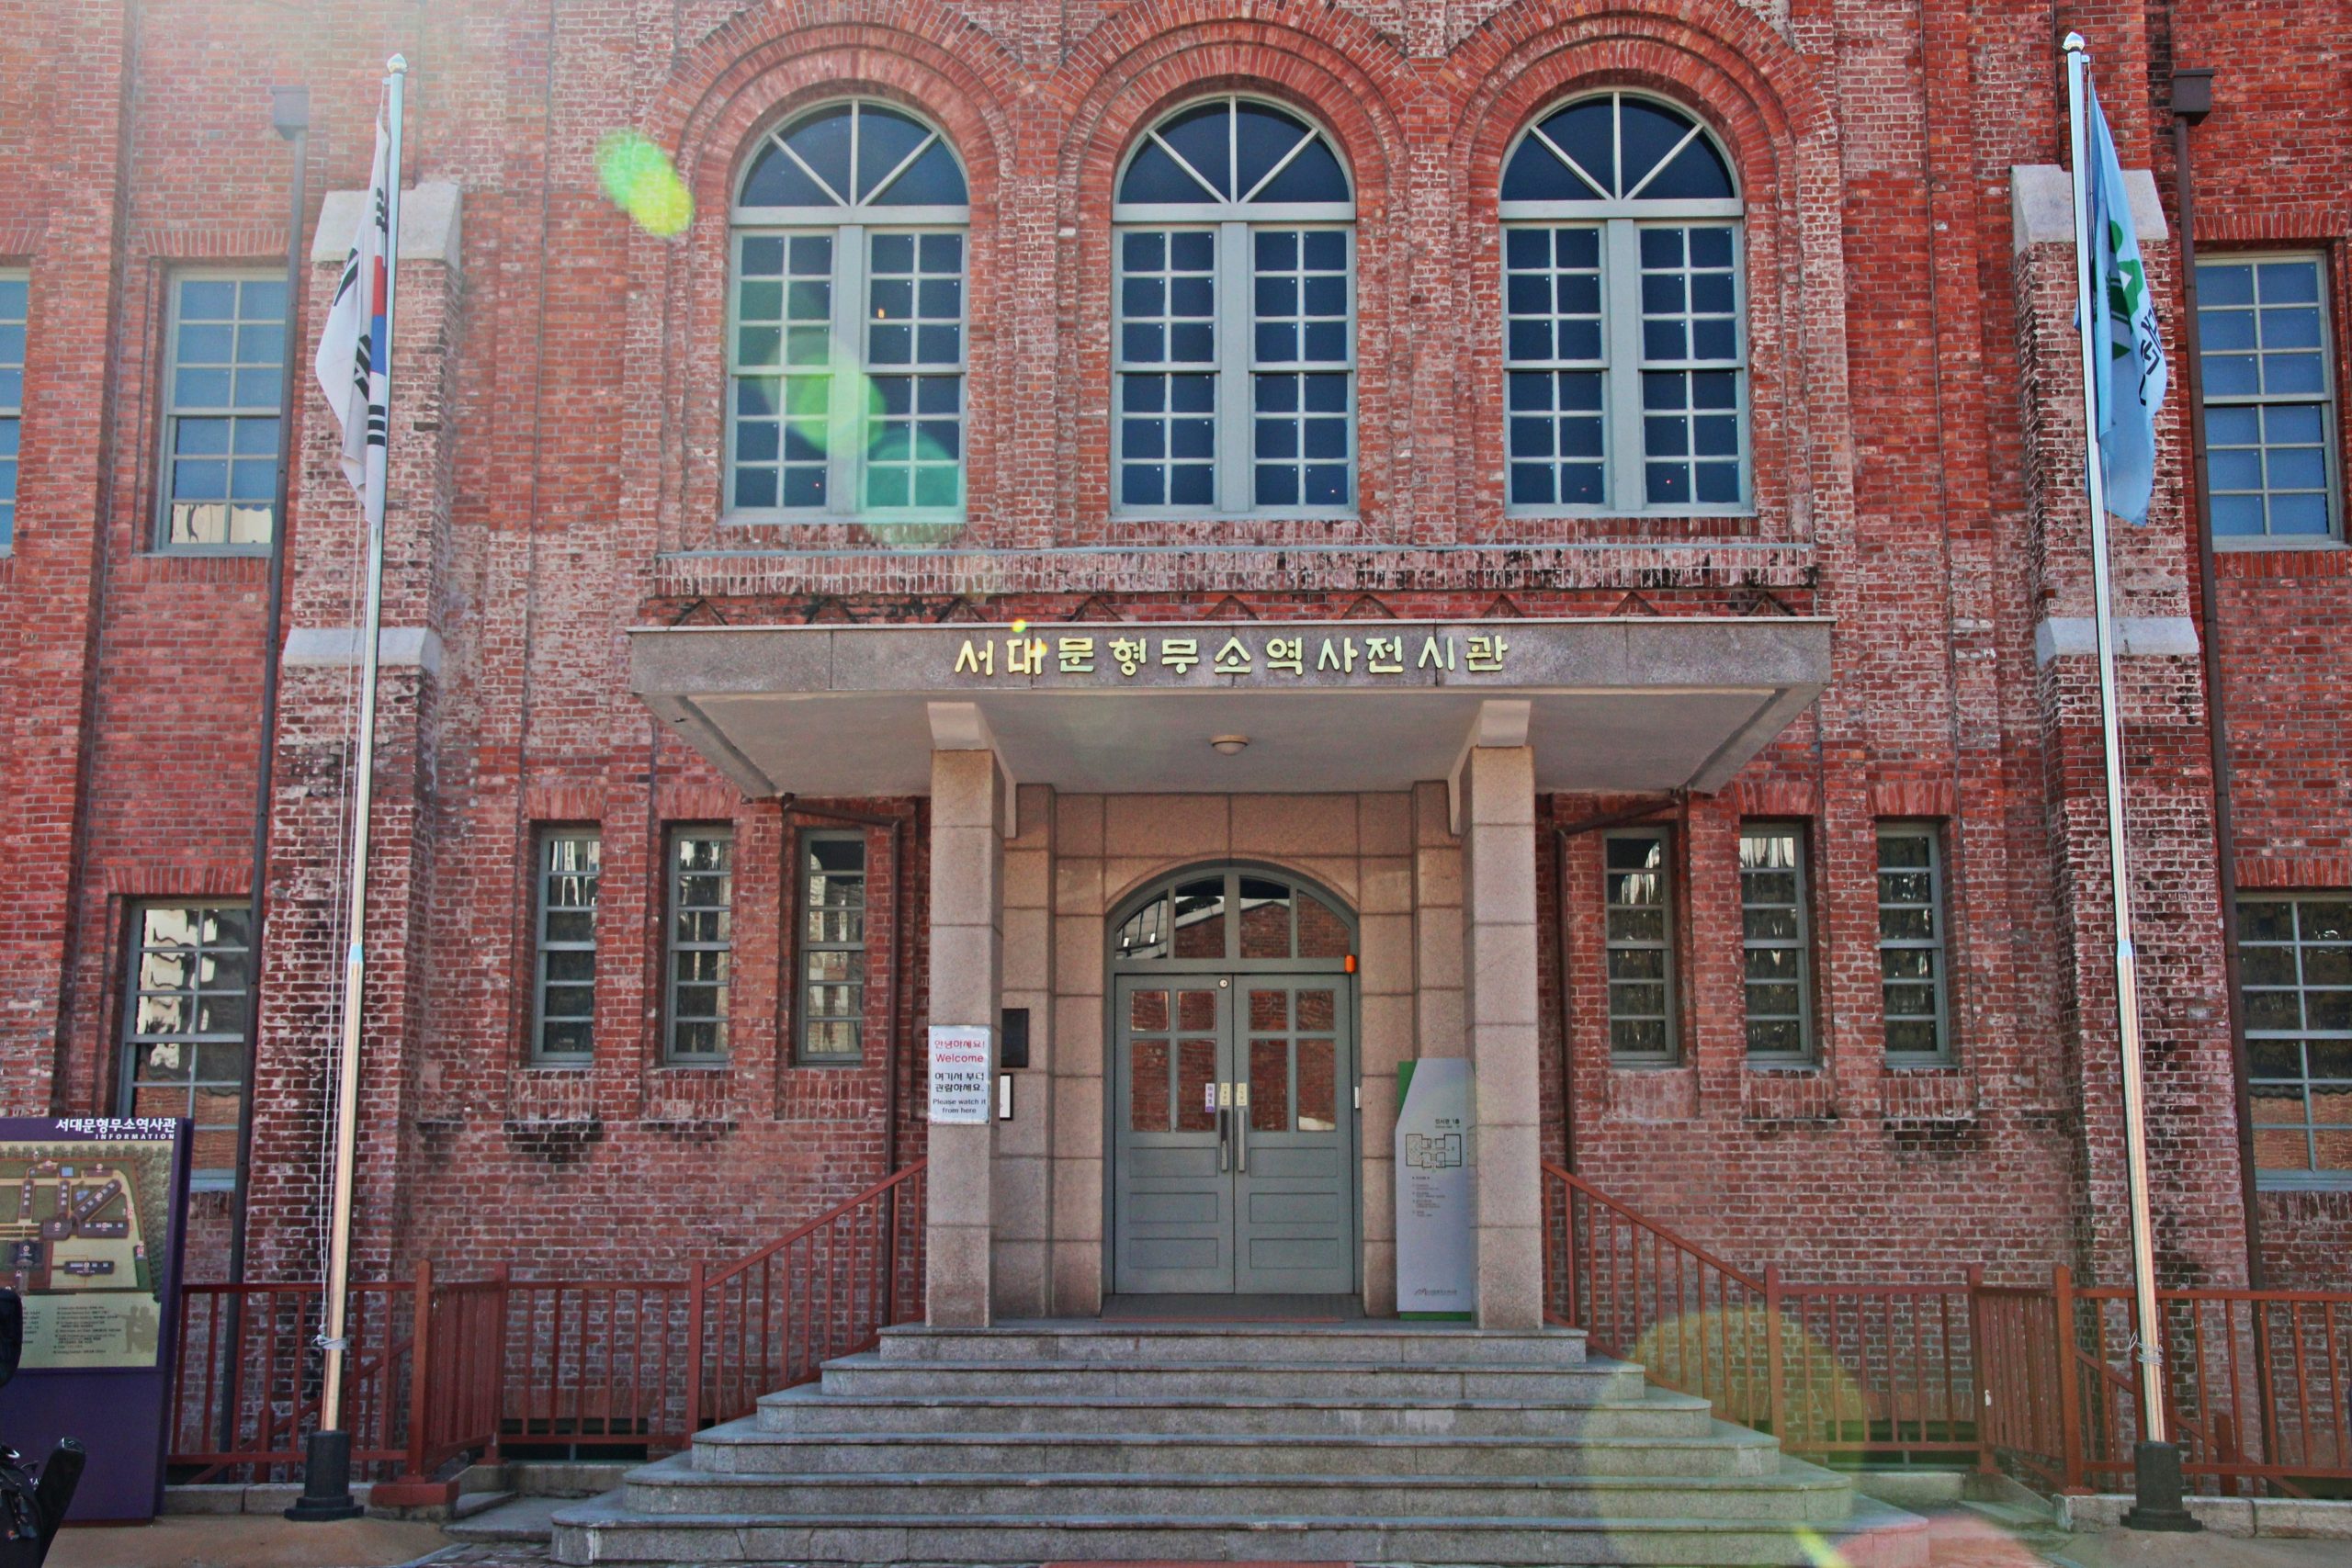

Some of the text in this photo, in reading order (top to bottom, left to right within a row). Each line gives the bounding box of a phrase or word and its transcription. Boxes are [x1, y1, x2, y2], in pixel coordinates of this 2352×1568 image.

[954, 636, 1509, 676] 서대문형무소역사전시관
[935, 1054, 984, 1063] Welcome
[934, 1072, 963, 1081] 여기서
[55, 1118, 176, 1134] 서대문형무소역사관
